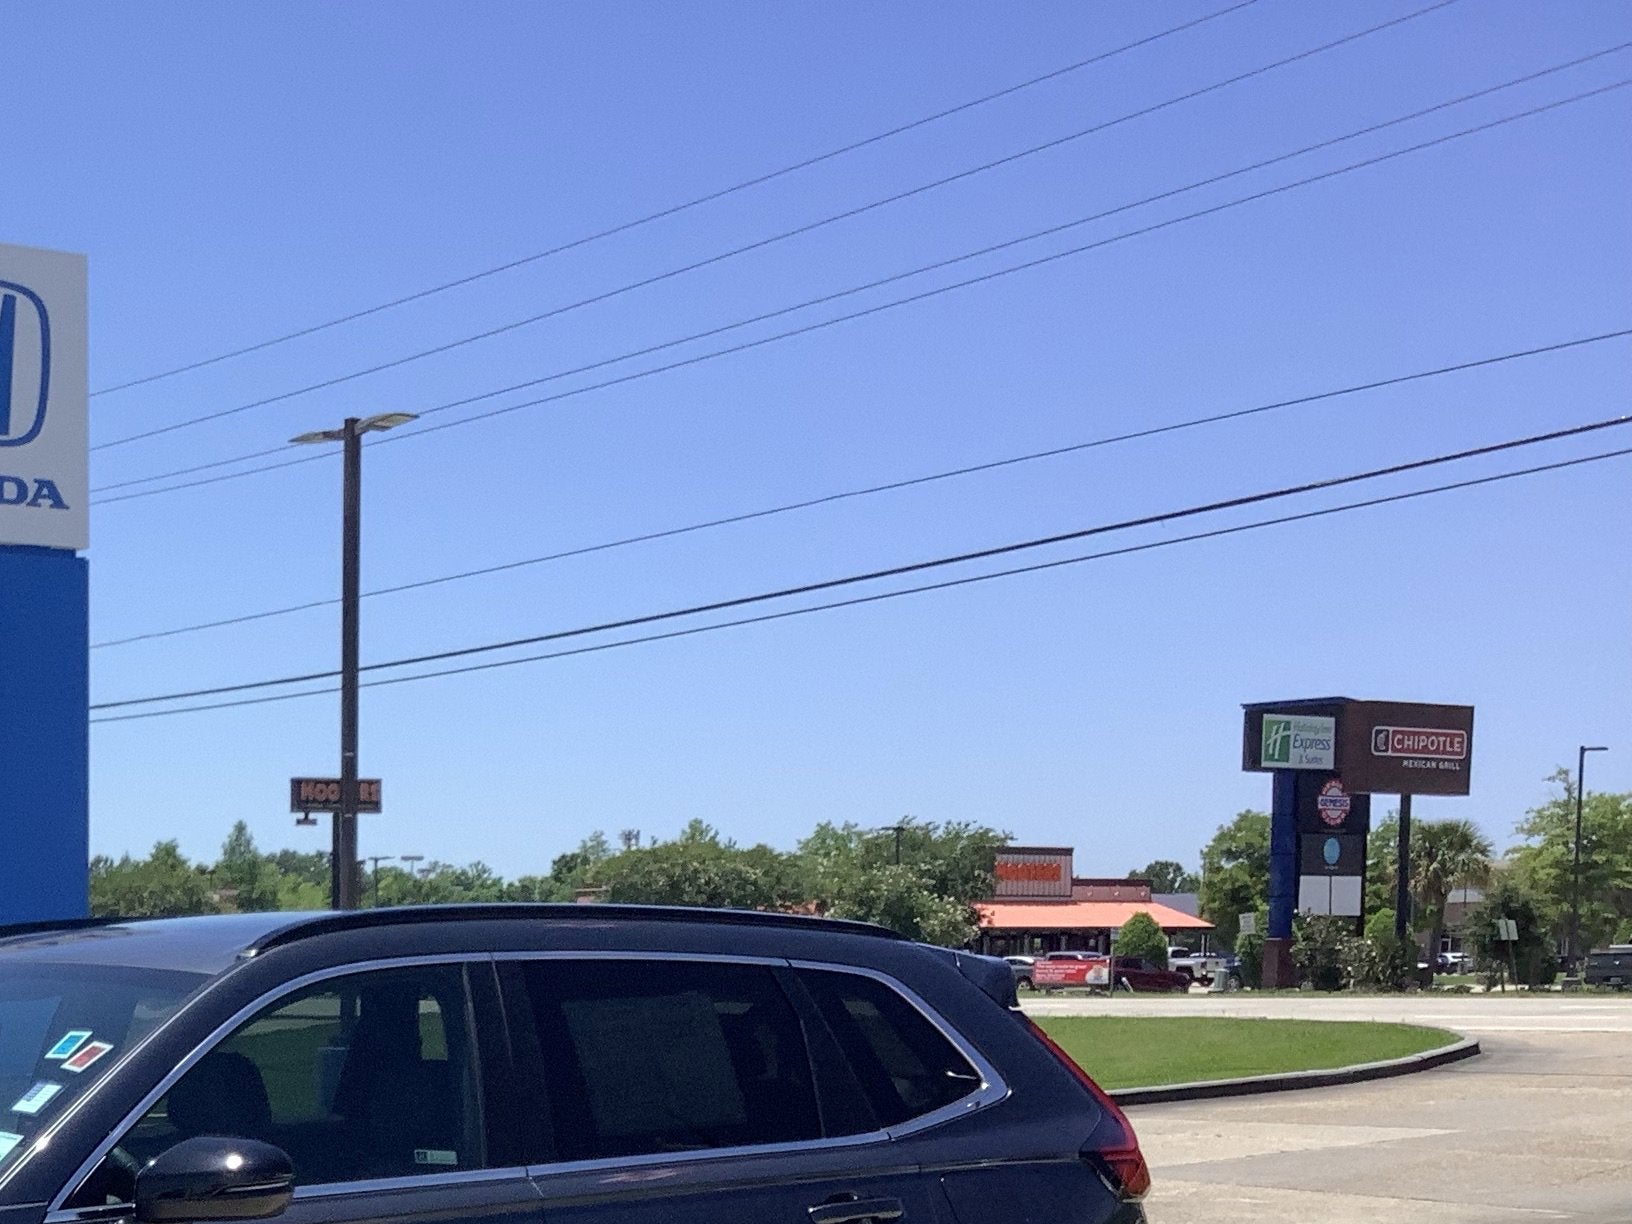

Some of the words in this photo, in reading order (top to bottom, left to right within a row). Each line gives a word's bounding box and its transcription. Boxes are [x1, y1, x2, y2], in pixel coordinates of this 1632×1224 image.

[1293, 733, 1331, 751] Express
[1393, 734, 1462, 752] CHIPOTLE
[1402, 759, 1437, 769] MEXICAN
[1439, 761, 1461, 771] GRILL
